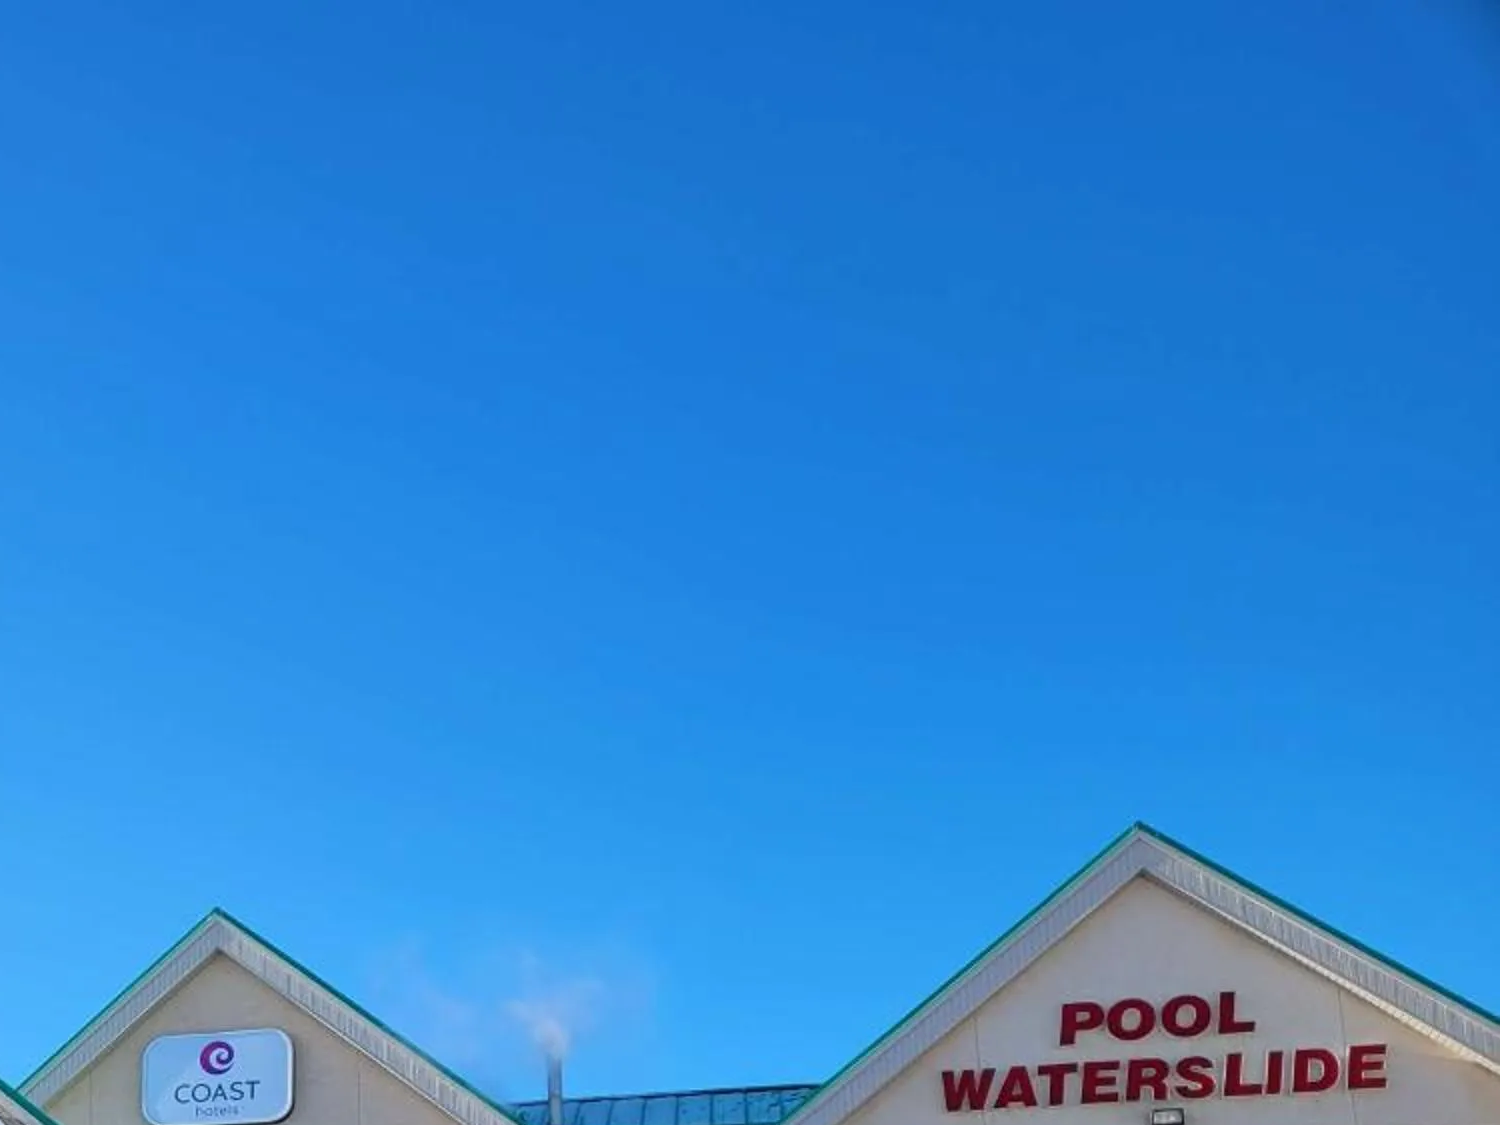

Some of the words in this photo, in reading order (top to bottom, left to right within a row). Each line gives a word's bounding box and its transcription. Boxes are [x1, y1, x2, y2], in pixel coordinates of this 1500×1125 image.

[1059, 991, 1256, 1046] POOL
[174, 1080, 260, 1104] COAST
[941, 1043, 1388, 1113] WATERSLIDE
